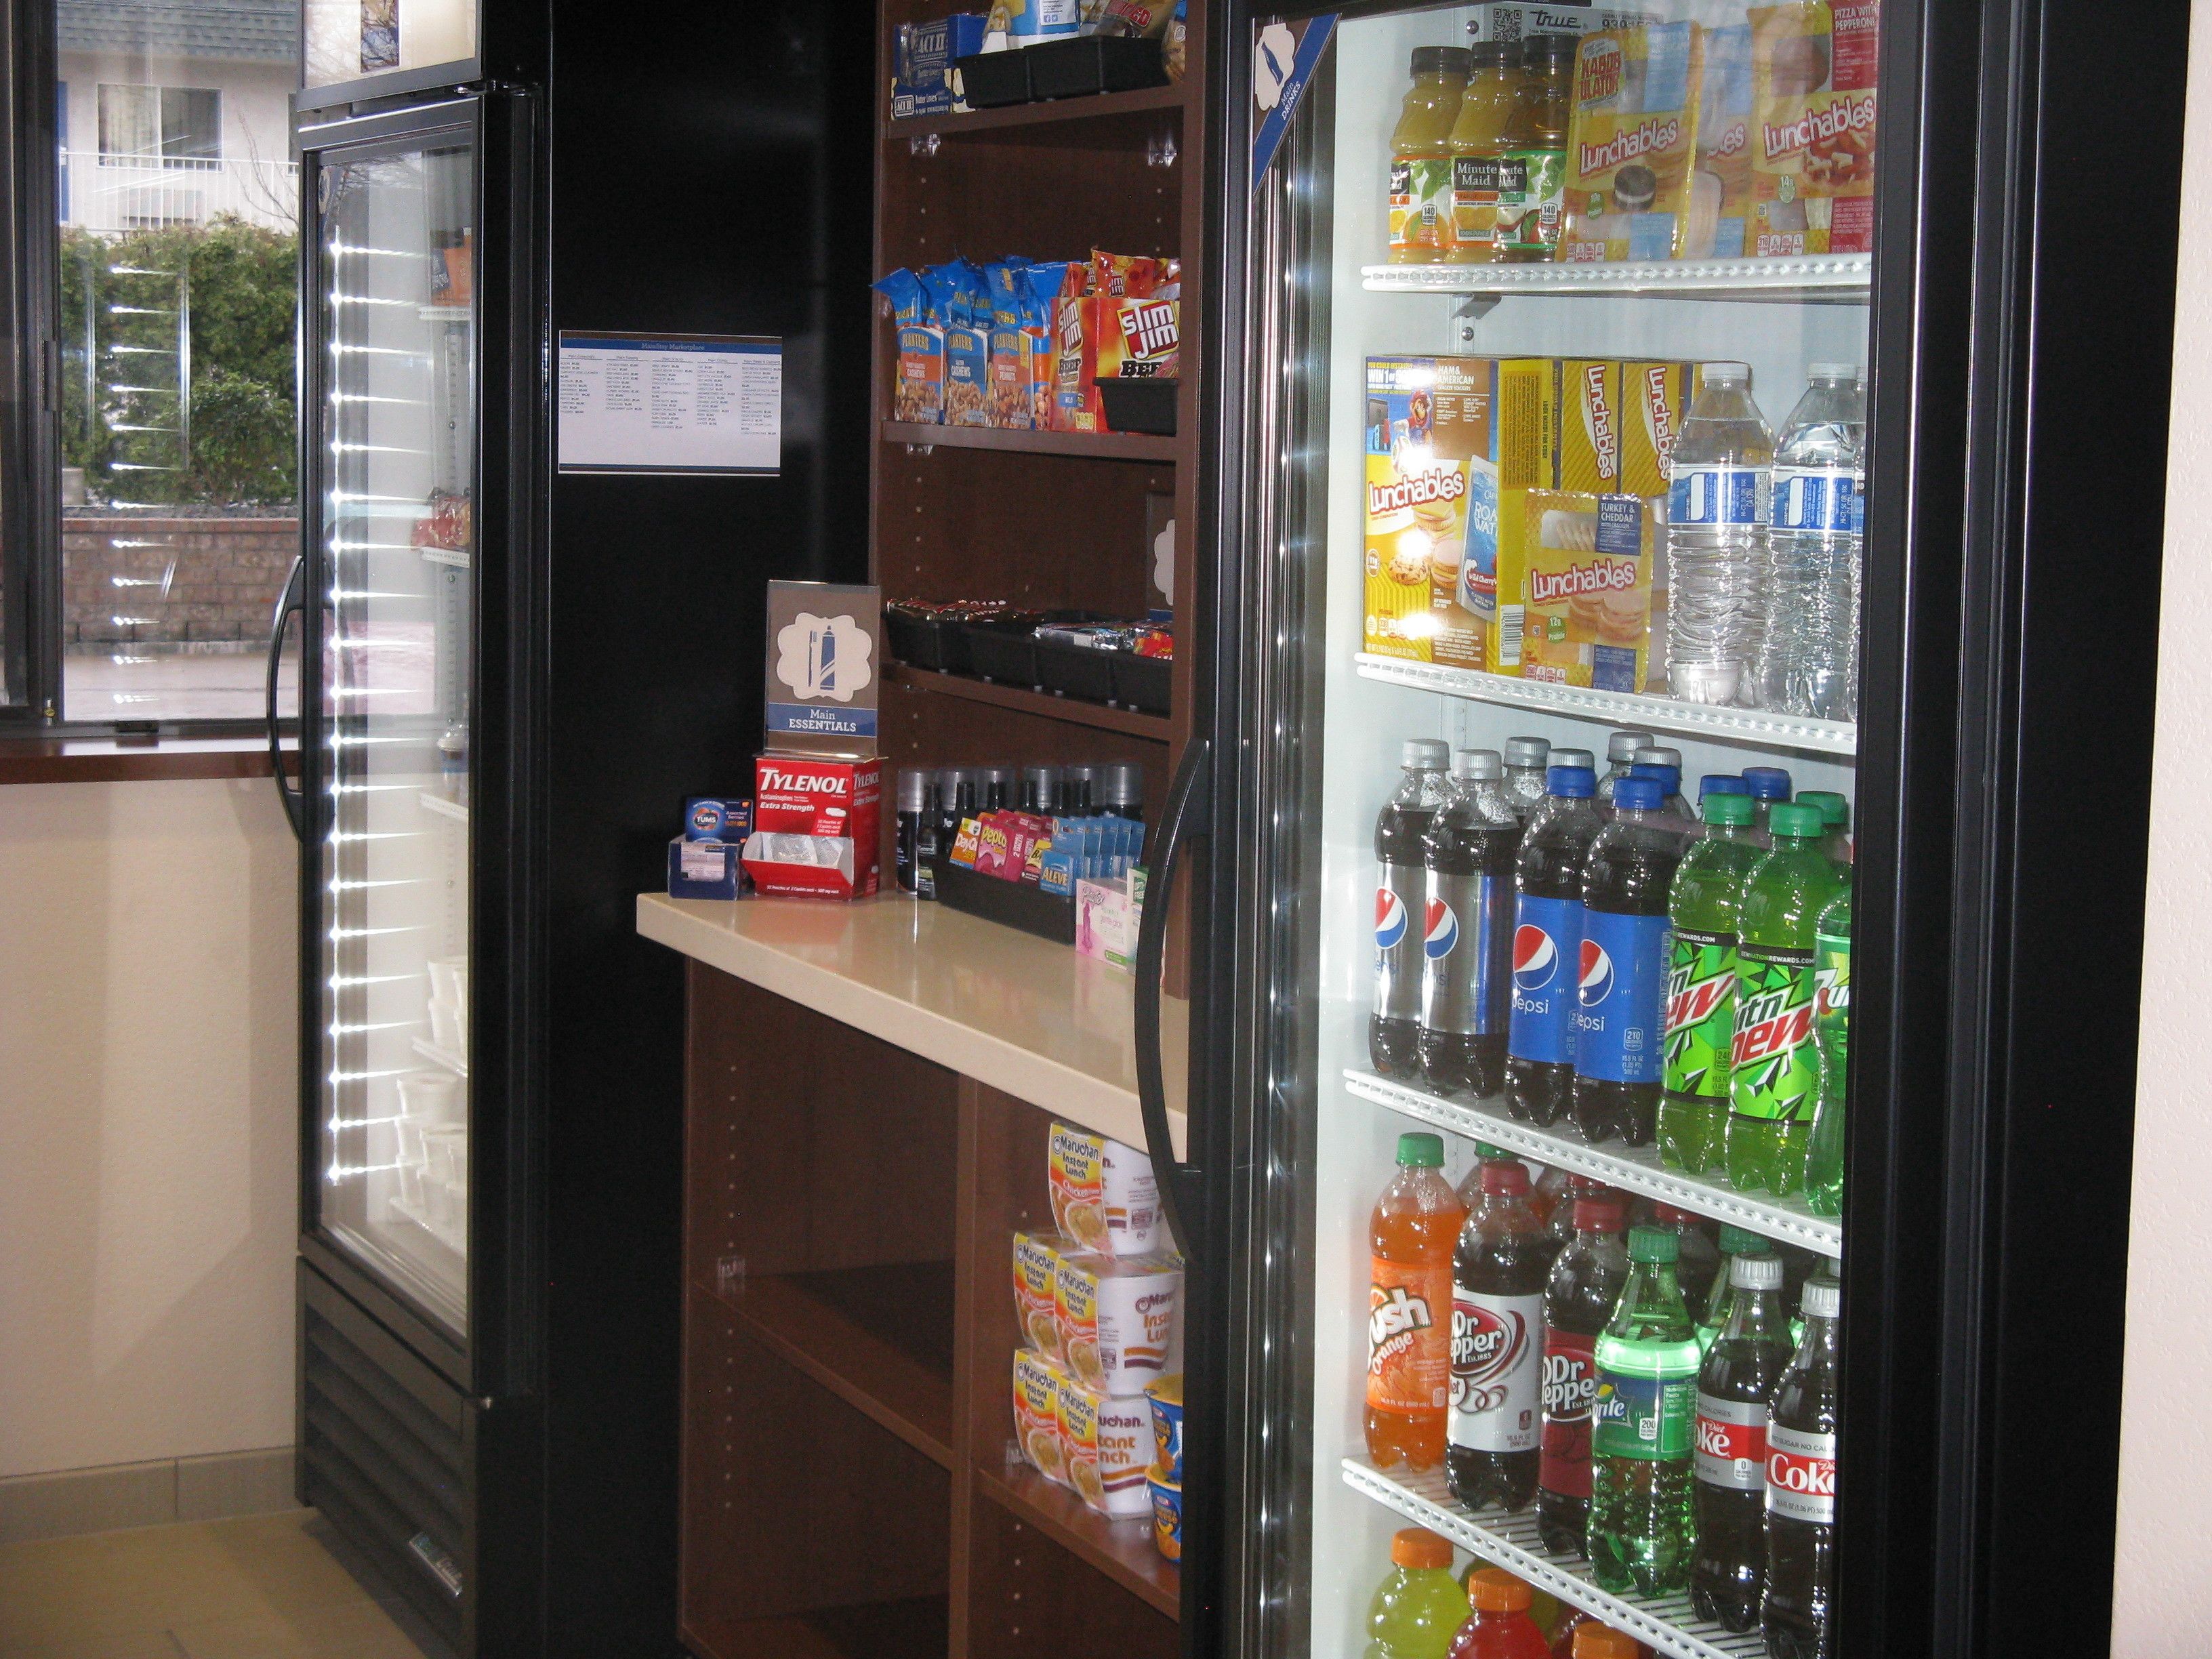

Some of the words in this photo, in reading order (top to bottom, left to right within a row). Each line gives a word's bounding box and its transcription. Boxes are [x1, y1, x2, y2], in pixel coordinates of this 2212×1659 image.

[1835, 9, 1855, 19] PIZZA
[1281, 81, 1300, 121] DRINKS
[1763, 96, 1875, 157] Lunchables
[1580, 118, 1679, 175] Lunchables
[1457, 162, 1498, 175] Minute
[1461, 173, 1491, 186] Maid
[1424, 206, 1435, 216] 140
[1543, 205, 1555, 214] 140
[1368, 369, 1384, 384] WIN
[1437, 375, 1475, 385] AMERICAN
[1586, 364, 1614, 479] Lunchables
[1647, 366, 1671, 480] Lunchables
[1368, 469, 1465, 514] Lunchables
[1600, 502, 1628, 514] TURKEY
[1629, 504, 1635, 514] &
[1600, 511, 1634, 523] CHEDDAR
[1532, 559, 1635, 600] Lunchables
[1549, 617, 1561, 627] 12g
[811, 709, 836, 720] Main
[788, 718, 857, 733] ESSENTIALS
[760, 769, 847, 794] TYLENOL
[853, 771, 879, 790] TYLENOL
[760, 802, 780, 810] Extra
[781, 802, 815, 813] Strength
[697, 815, 716, 823] TUMS
[1042, 867, 1068, 886] ALEVE
[1511, 997, 1549, 1015] pepsi
[1576, 1013, 1605, 1032] epsi
[1627, 1031, 1641, 1040] 210
[1061, 1135, 1099, 1161] Maruchan
[1063, 1152, 1088, 1170] Instant
[1065, 1164, 1086, 1180] Lunch
[1023, 1245, 1055, 1273] Maruchan
[1027, 1273, 1044, 1291] Lunch
[1065, 1271, 1094, 1299] Maruchan
[1067, 1299, 1084, 1317] Lunch
[1452, 1310, 1479, 1338] Dr
[1024, 1364, 1057, 1392] Maruchan
[1552, 1355, 1586, 1385] Dr
[1025, 1380, 1047, 1400] Instant
[1027, 1391, 1045, 1410] Lunch
[1065, 1389, 1094, 1421] Maruchan
[1593, 1395, 1625, 1420] prite
[1068, 1417, 1085, 1437] Lunch
[1099, 1414, 1141, 1429] uchan
[1642, 1420, 1656, 1429] 200
[1099, 1435, 1136, 1449] tant
[1099, 1452, 1131, 1465] nch
